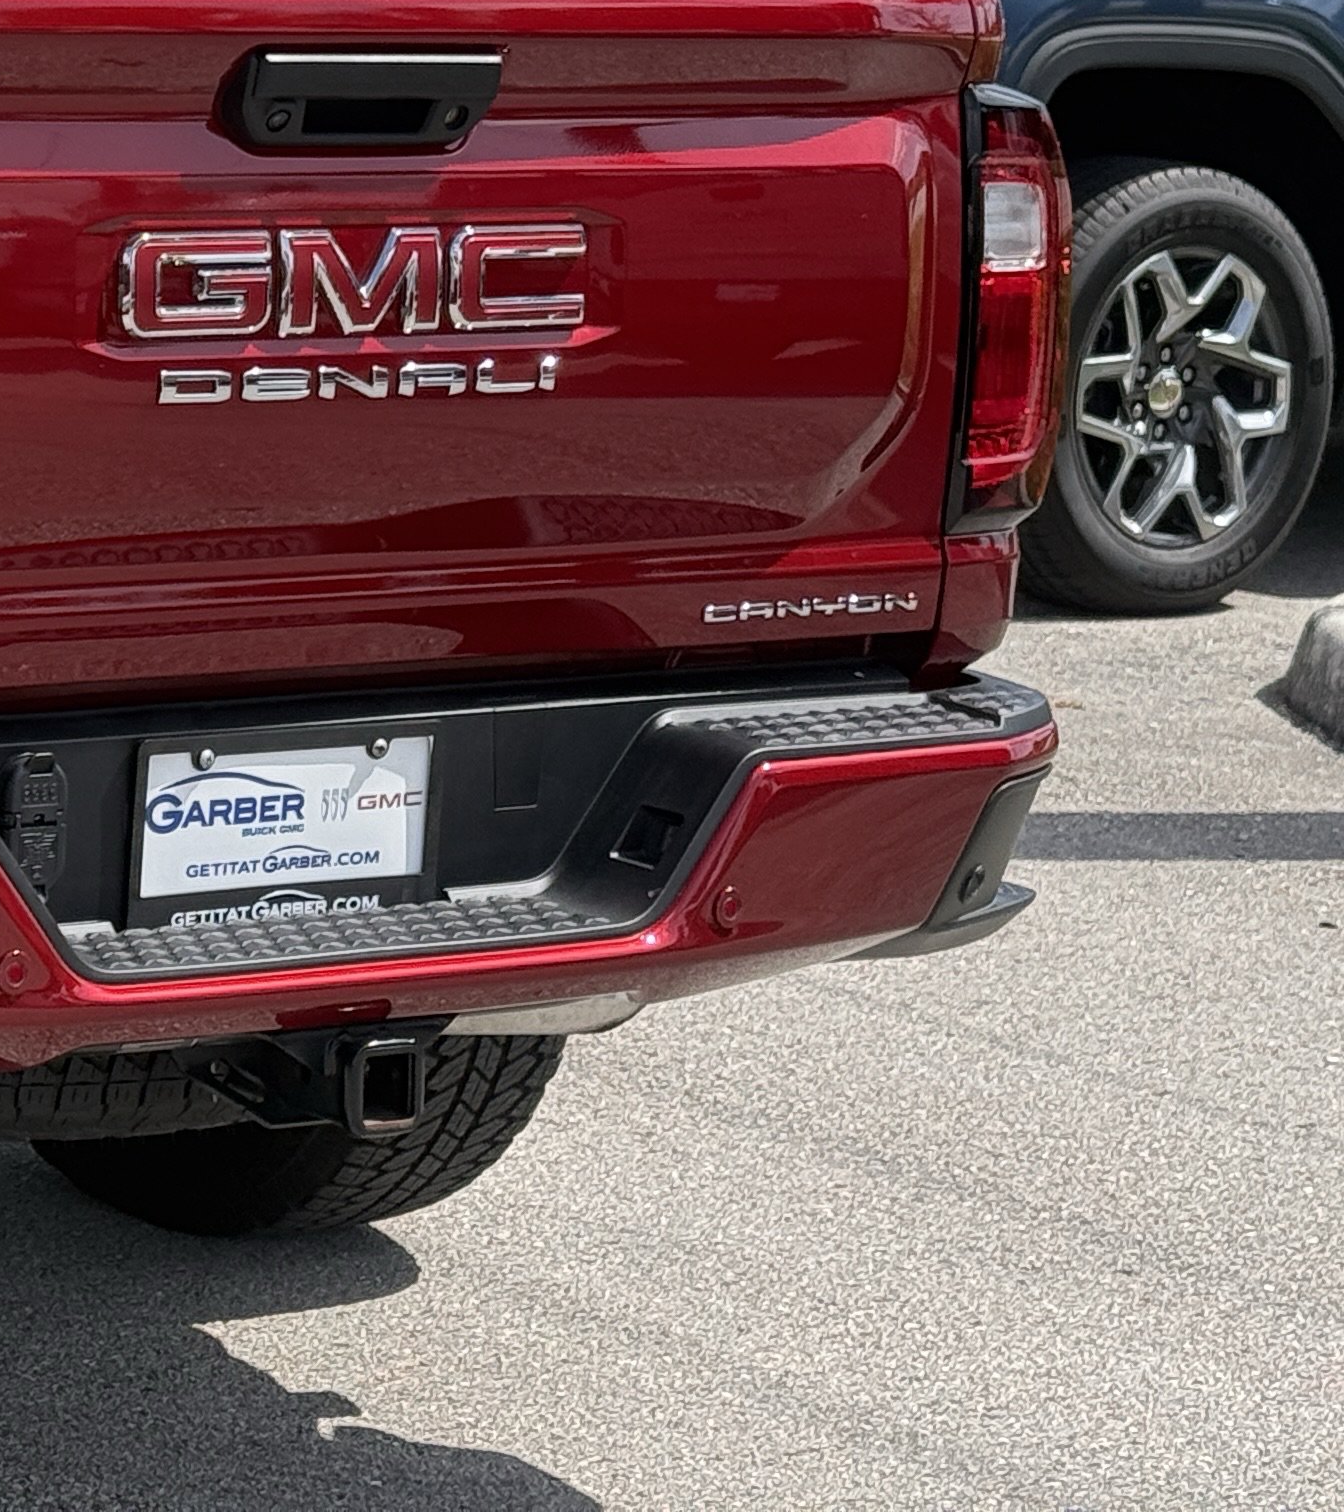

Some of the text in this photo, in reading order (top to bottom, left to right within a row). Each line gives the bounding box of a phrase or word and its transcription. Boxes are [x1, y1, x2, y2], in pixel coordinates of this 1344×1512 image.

[120, 223, 587, 339] GMC
[158, 356, 561, 405] DENALI
[703, 591, 919, 624] CANYON
[146, 791, 424, 834] GARBER GMC
[241, 823, 305, 837] BUICK GMC
